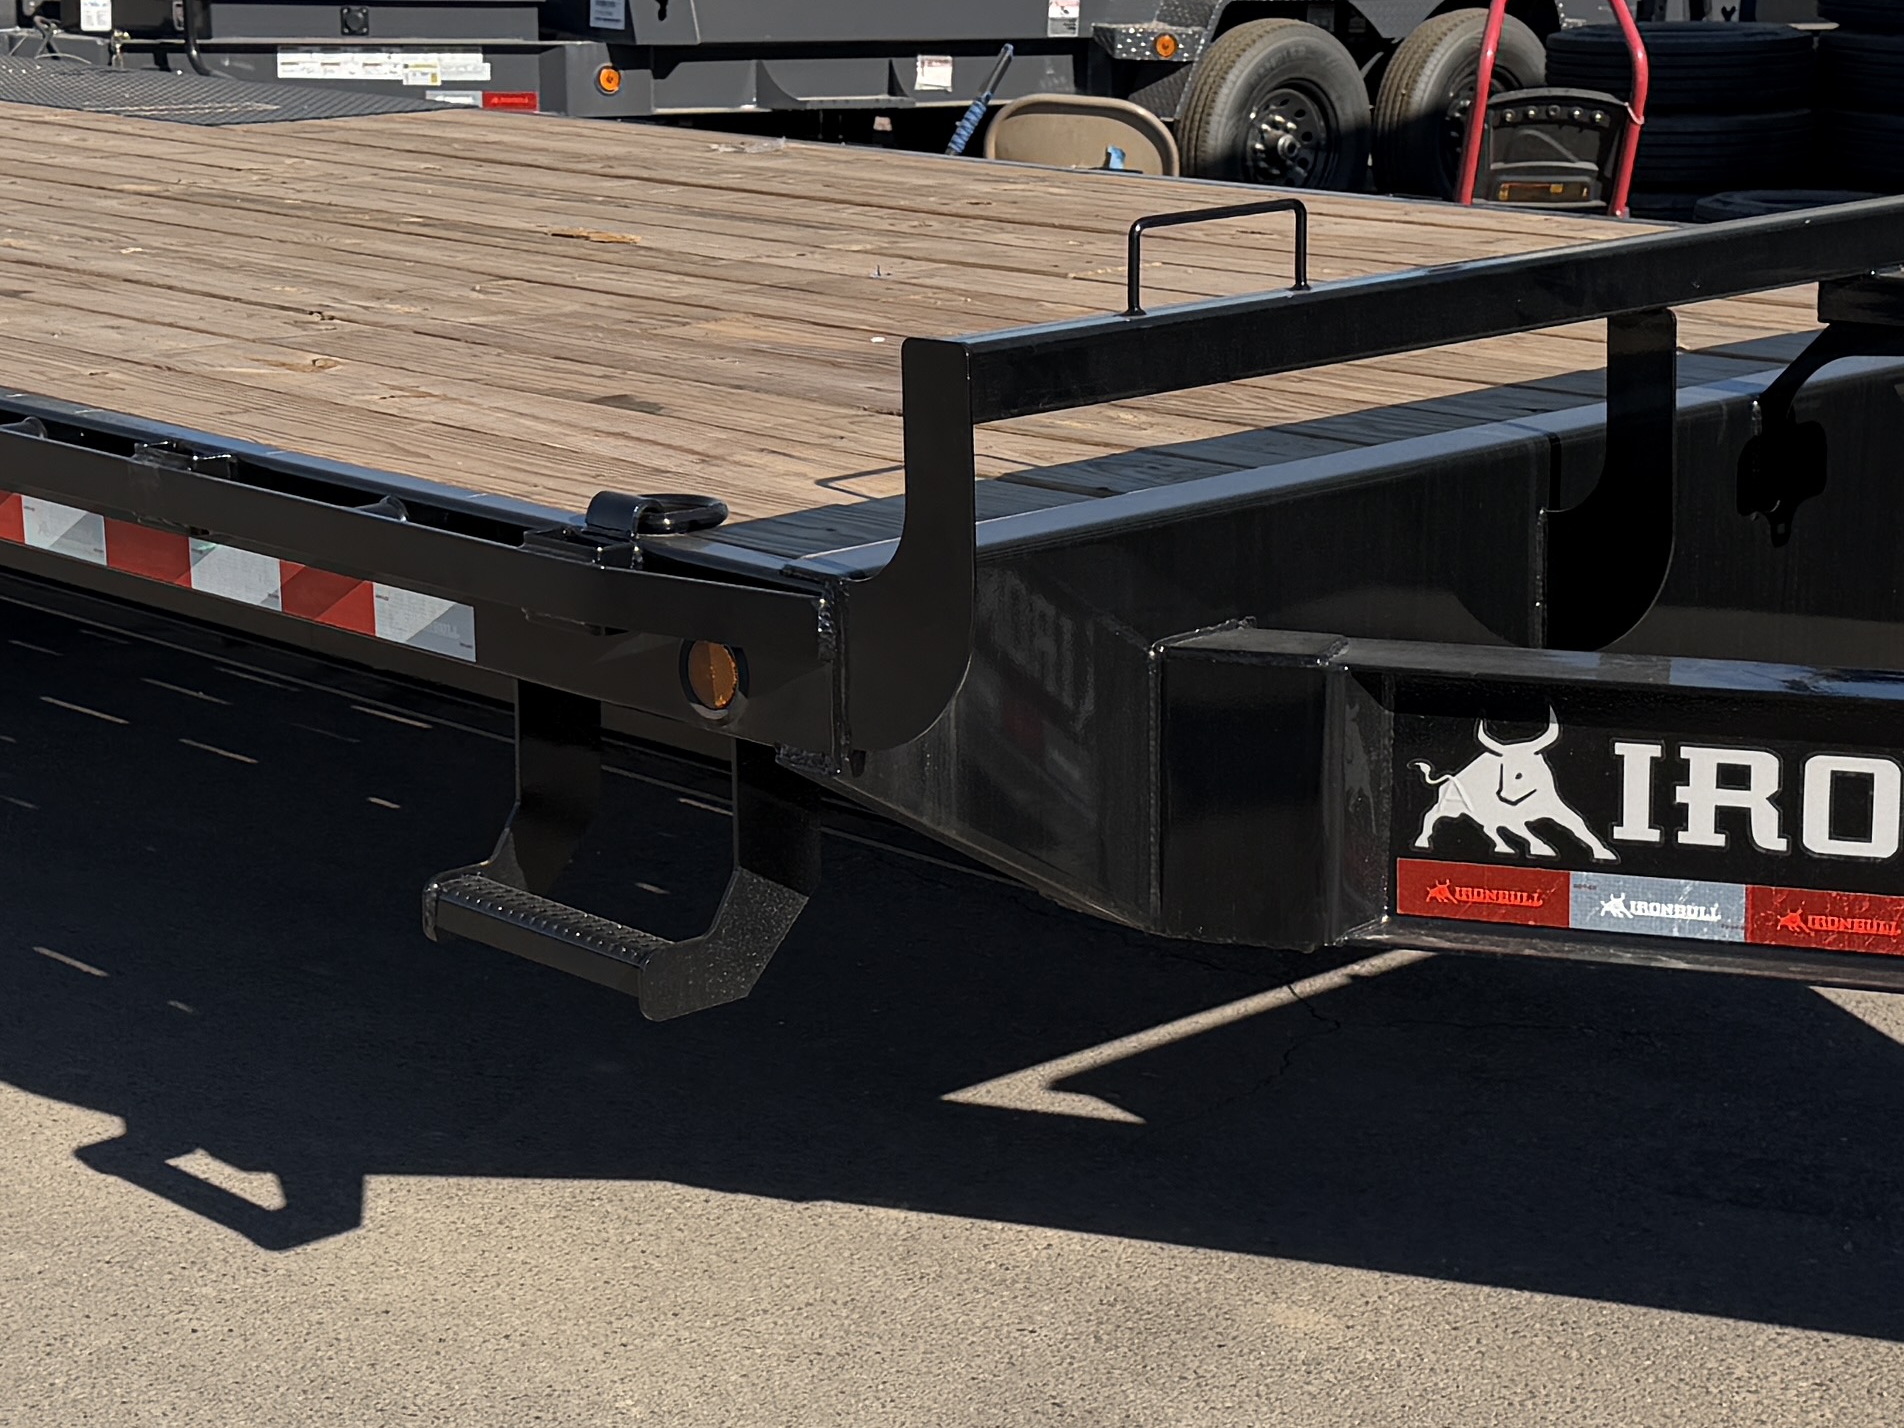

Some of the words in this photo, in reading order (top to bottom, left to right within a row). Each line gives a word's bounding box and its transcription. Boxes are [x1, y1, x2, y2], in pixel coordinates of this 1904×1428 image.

[1454, 885, 1544, 907] IRONBULL
[1630, 900, 1721, 922] IRONBULL
[1808, 914, 1901, 936] IRONBULL
